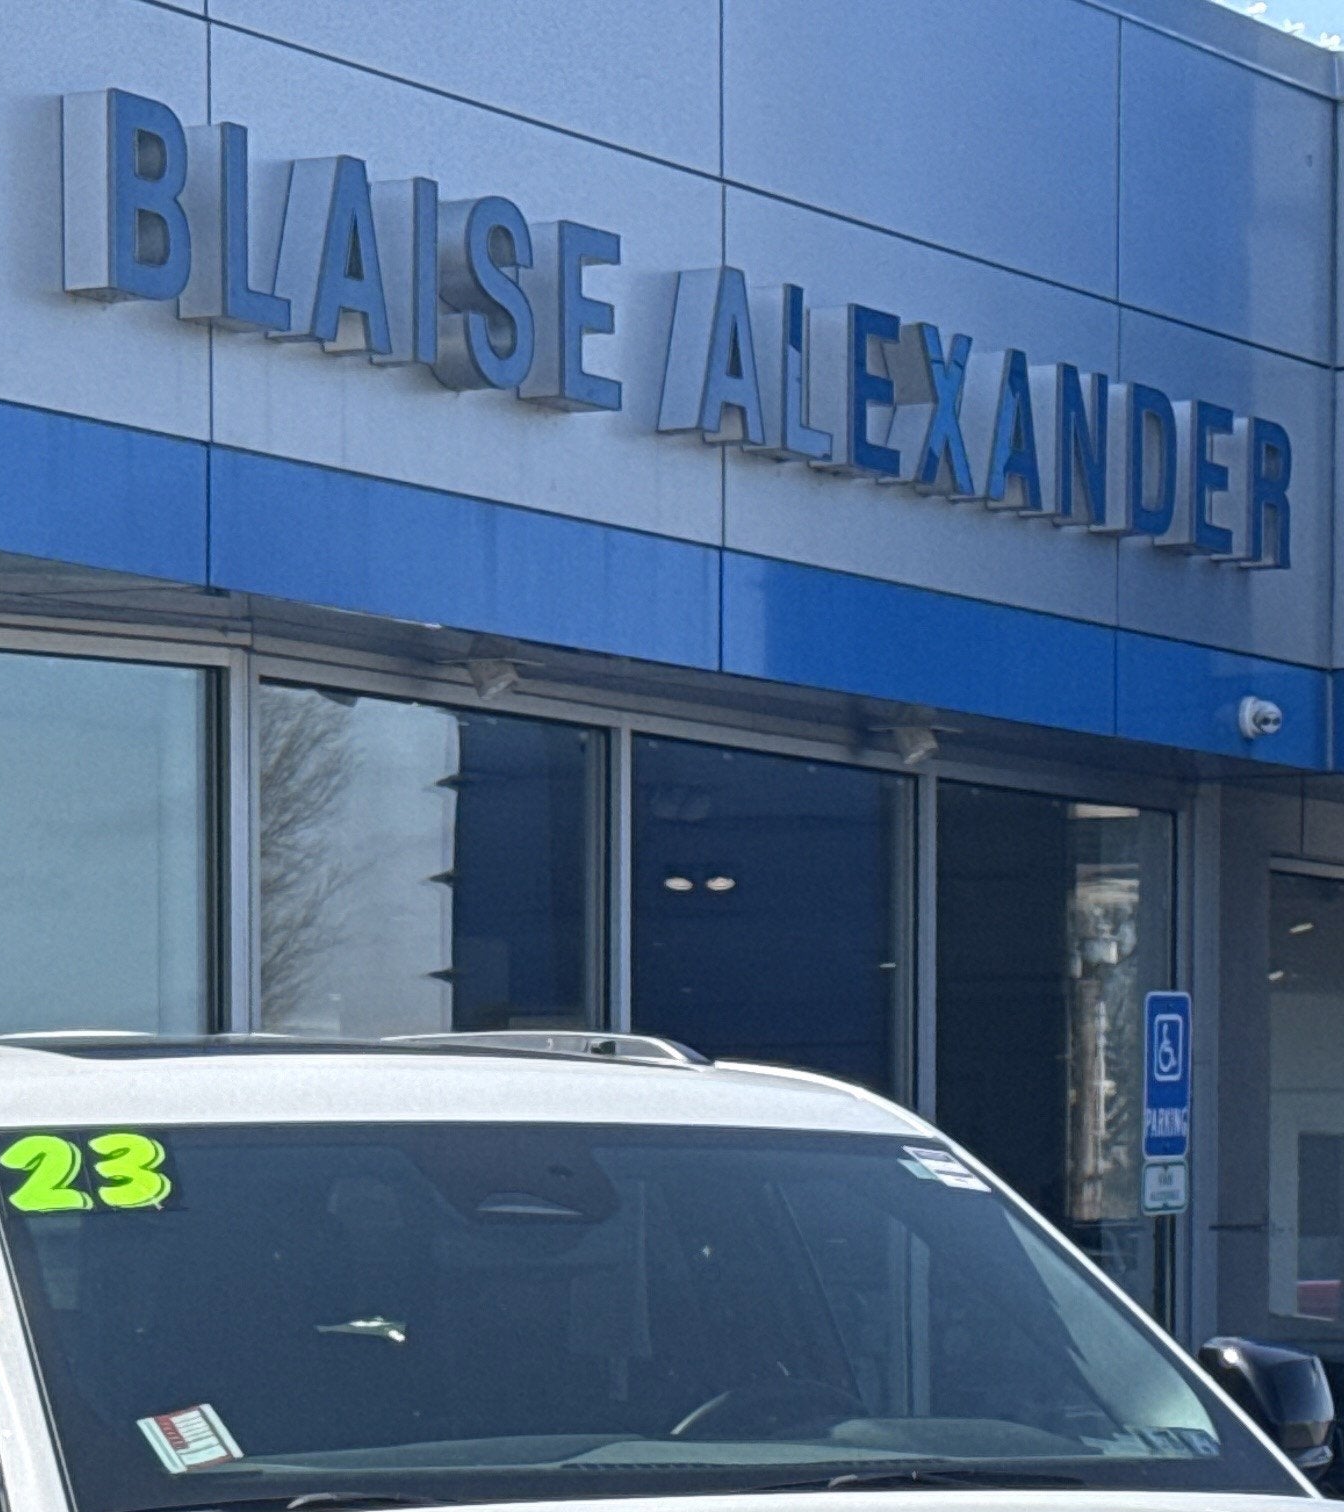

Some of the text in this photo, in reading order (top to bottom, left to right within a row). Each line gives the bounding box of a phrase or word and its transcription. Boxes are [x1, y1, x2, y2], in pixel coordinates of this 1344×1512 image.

[108, 86, 1293, 569] BLAISE ALEXANDER
[1145, 1106, 1188, 1138] PARKING
